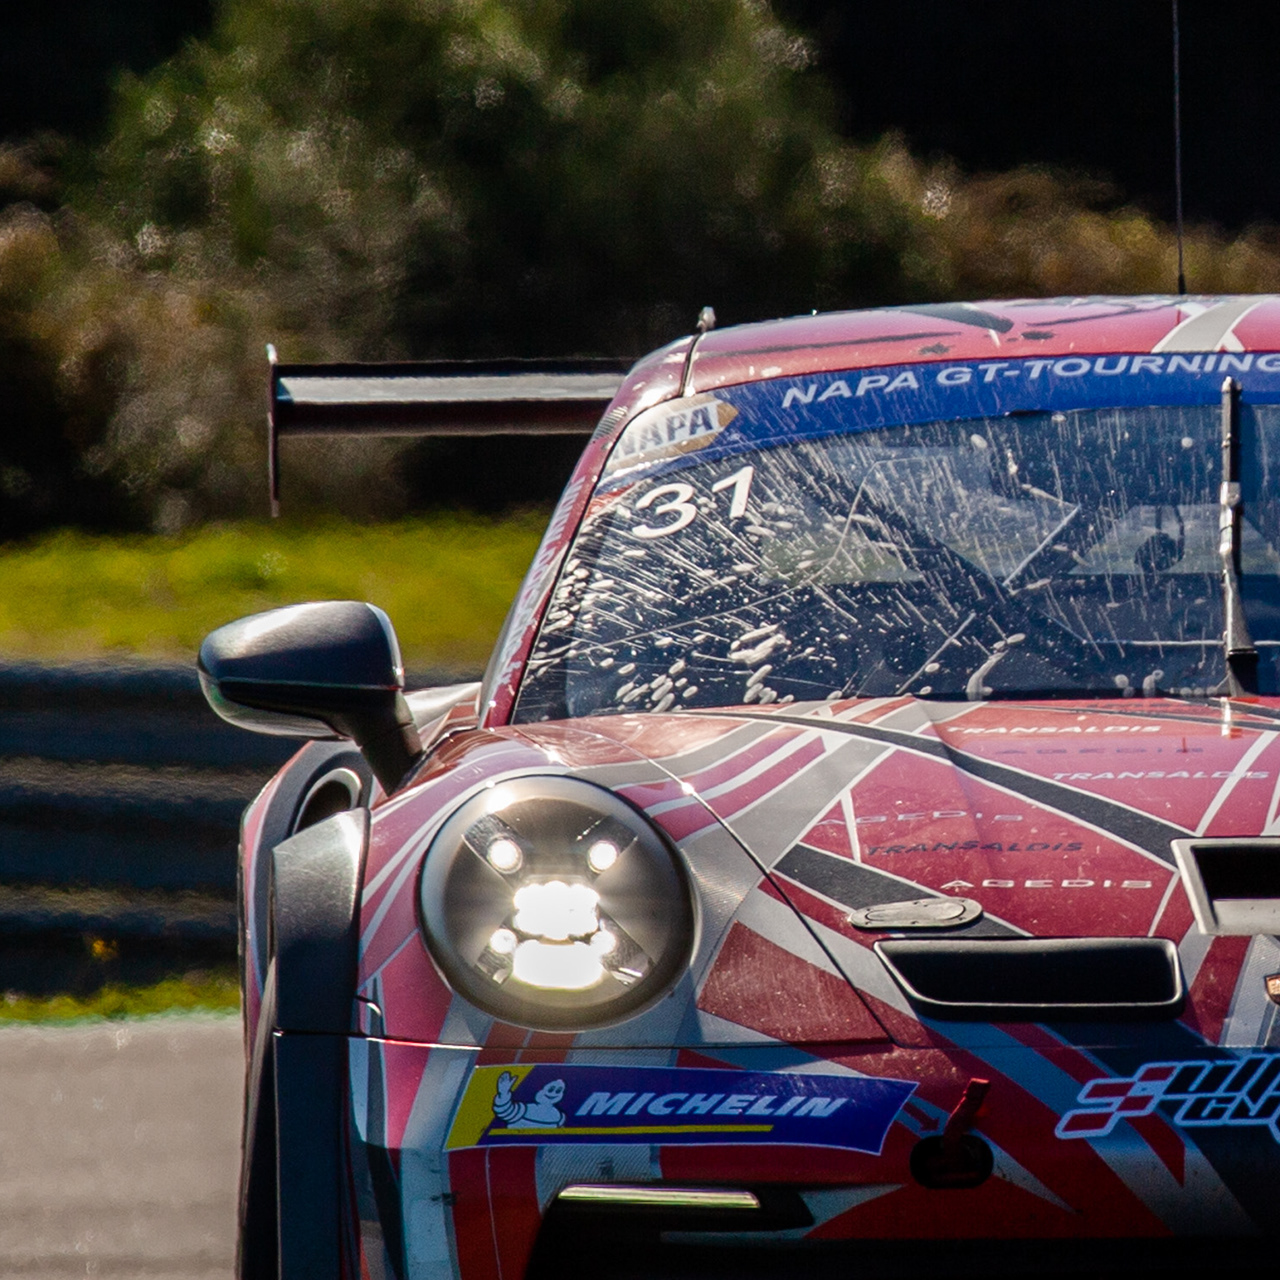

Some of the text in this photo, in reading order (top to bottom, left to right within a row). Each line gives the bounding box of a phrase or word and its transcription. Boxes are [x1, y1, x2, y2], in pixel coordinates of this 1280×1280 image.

[781, 371, 919, 409] NAPA
[631, 465, 754, 539] 31
[946, 725, 1162, 734] TRANSALDIS
[1052, 771, 1269, 781] TRANSALDIS
[867, 840, 1084, 856] TRANSALDIS
[575, 1092, 848, 1118] MICHELIN
